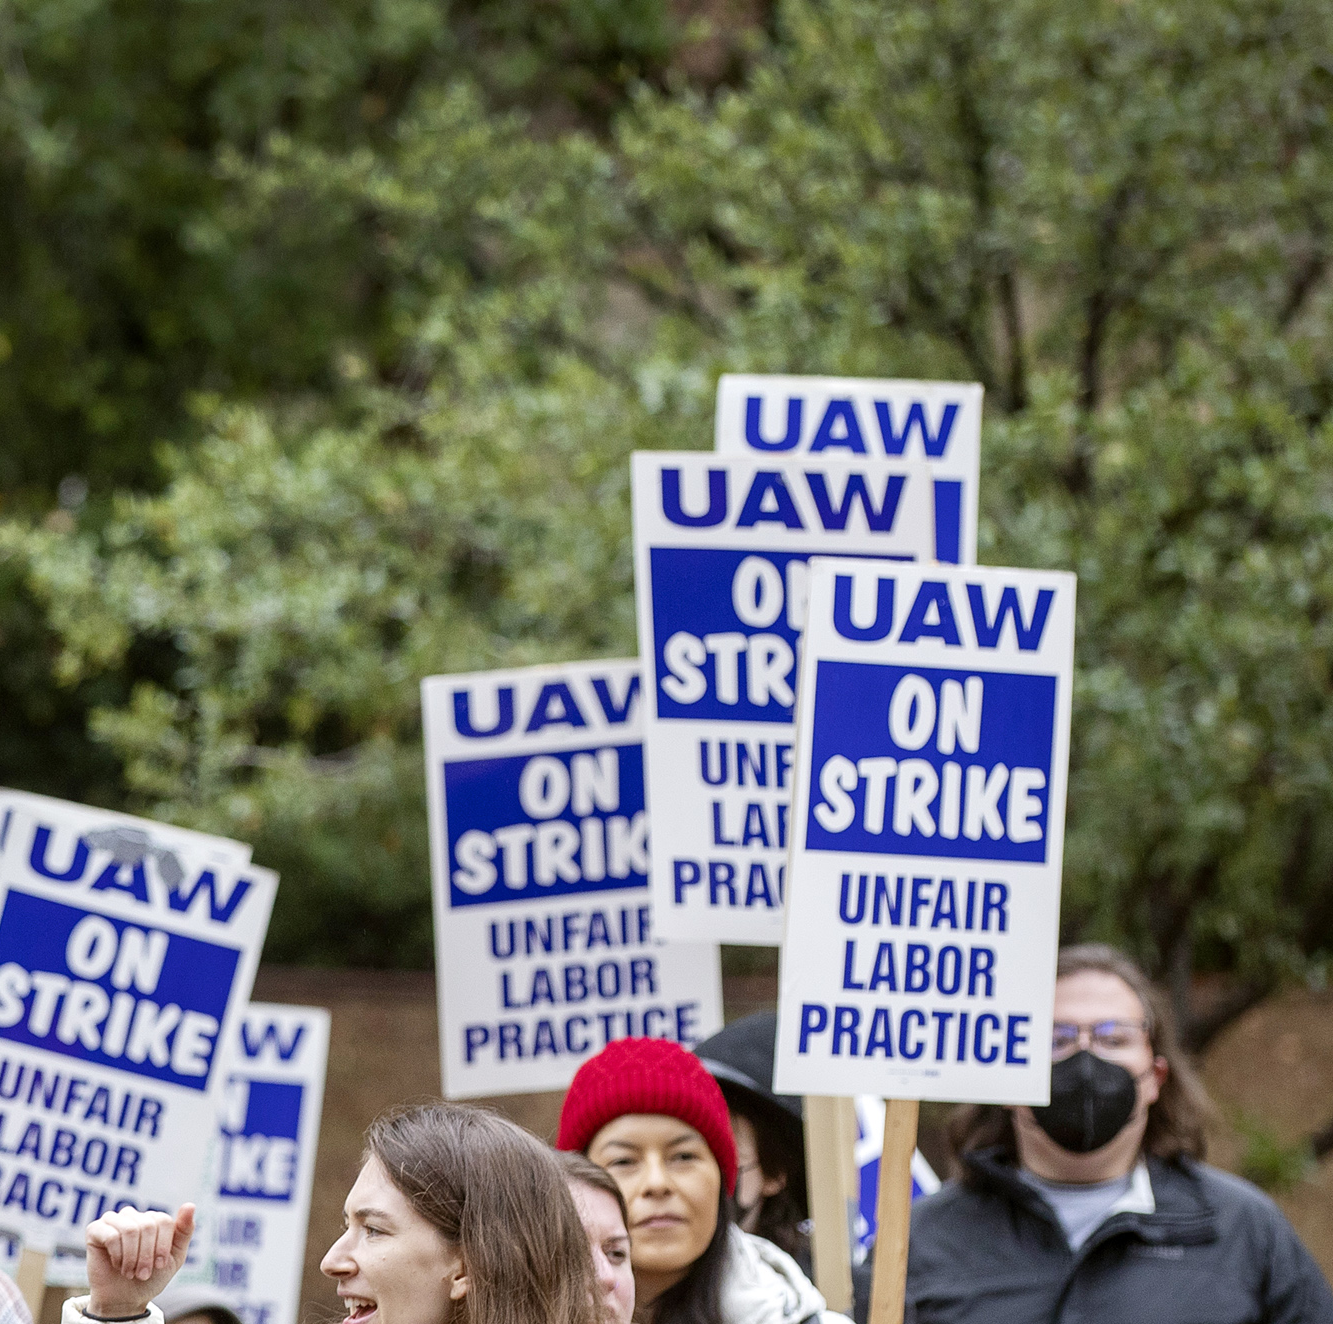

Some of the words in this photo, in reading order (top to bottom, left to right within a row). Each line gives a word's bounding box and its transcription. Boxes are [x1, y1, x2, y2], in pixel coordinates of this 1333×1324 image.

[744, 395, 960, 458] UAW
[658, 467, 908, 533] UAW
[832, 574, 1056, 652] UAW
[660, 630, 800, 709] STR
[888, 673, 985, 755] ON
[518, 748, 620, 821] ON
[700, 740, 795, 788] UNF
[813, 756, 1046, 844] STRIKE
[29, 825, 256, 923] UAW
[453, 815, 651, 895] STRIK
[838, 872, 1010, 934] UNFAIR
[66, 915, 170, 996] ON
[501, 957, 658, 1011] LABOR
[842, 939, 998, 998] LABOR
[798, 1003, 1031, 1066] PRACTICE
